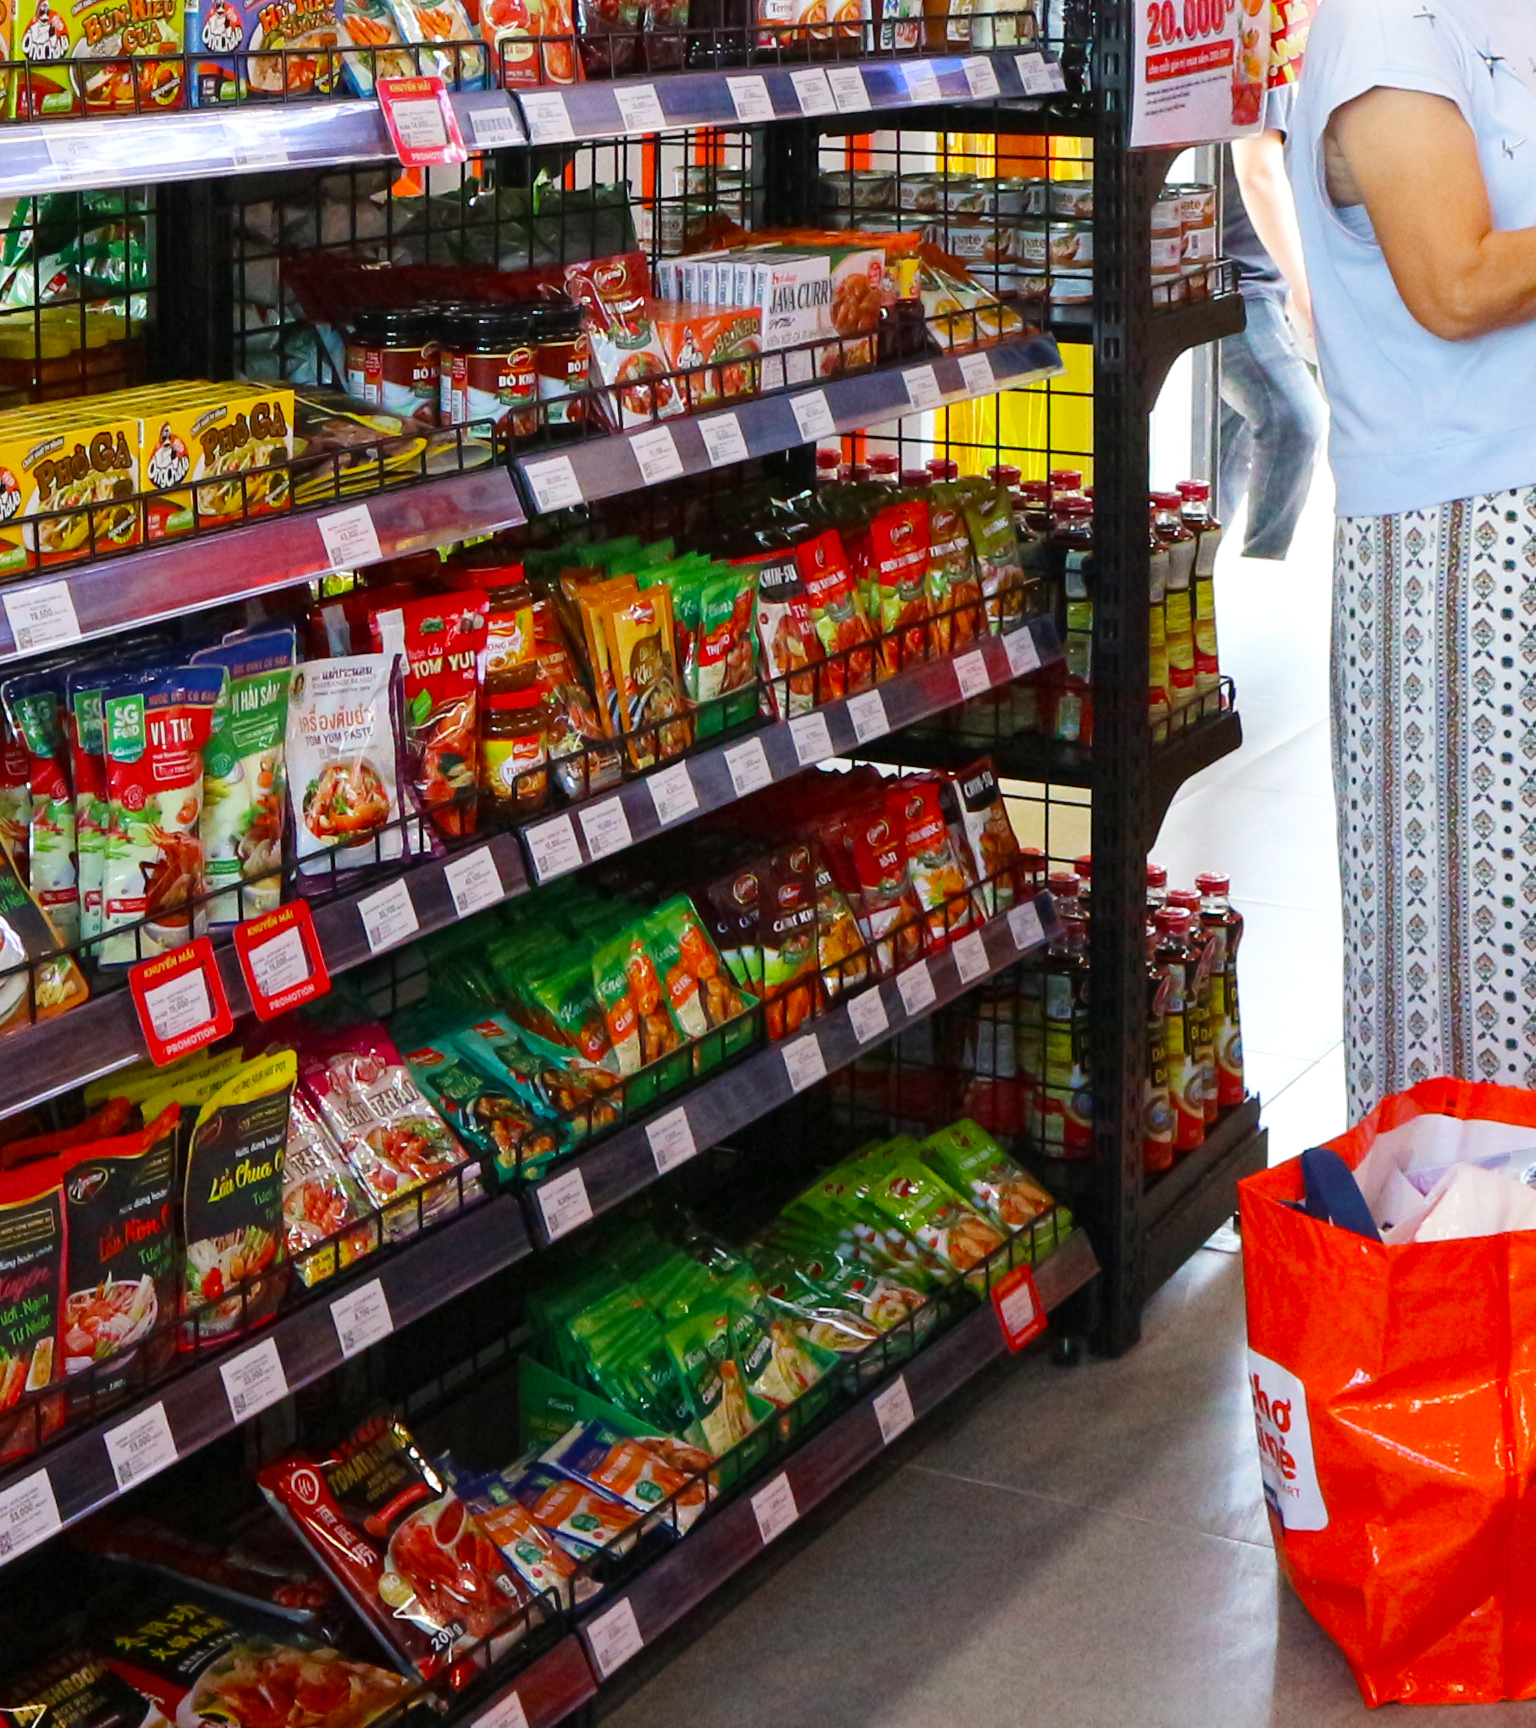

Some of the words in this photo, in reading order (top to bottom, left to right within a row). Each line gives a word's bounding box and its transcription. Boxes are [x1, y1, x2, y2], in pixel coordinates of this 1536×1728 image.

[122, 25, 162, 55] CUA
[769, 284, 796, 315] JAVA
[796, 277, 834, 308] CURRY
[413, 658, 443, 680] TOM
[114, 704, 139, 727] SG
[269, 984, 315, 1011] PROMOTION
[166, 1026, 217, 1055] PROMOTION
